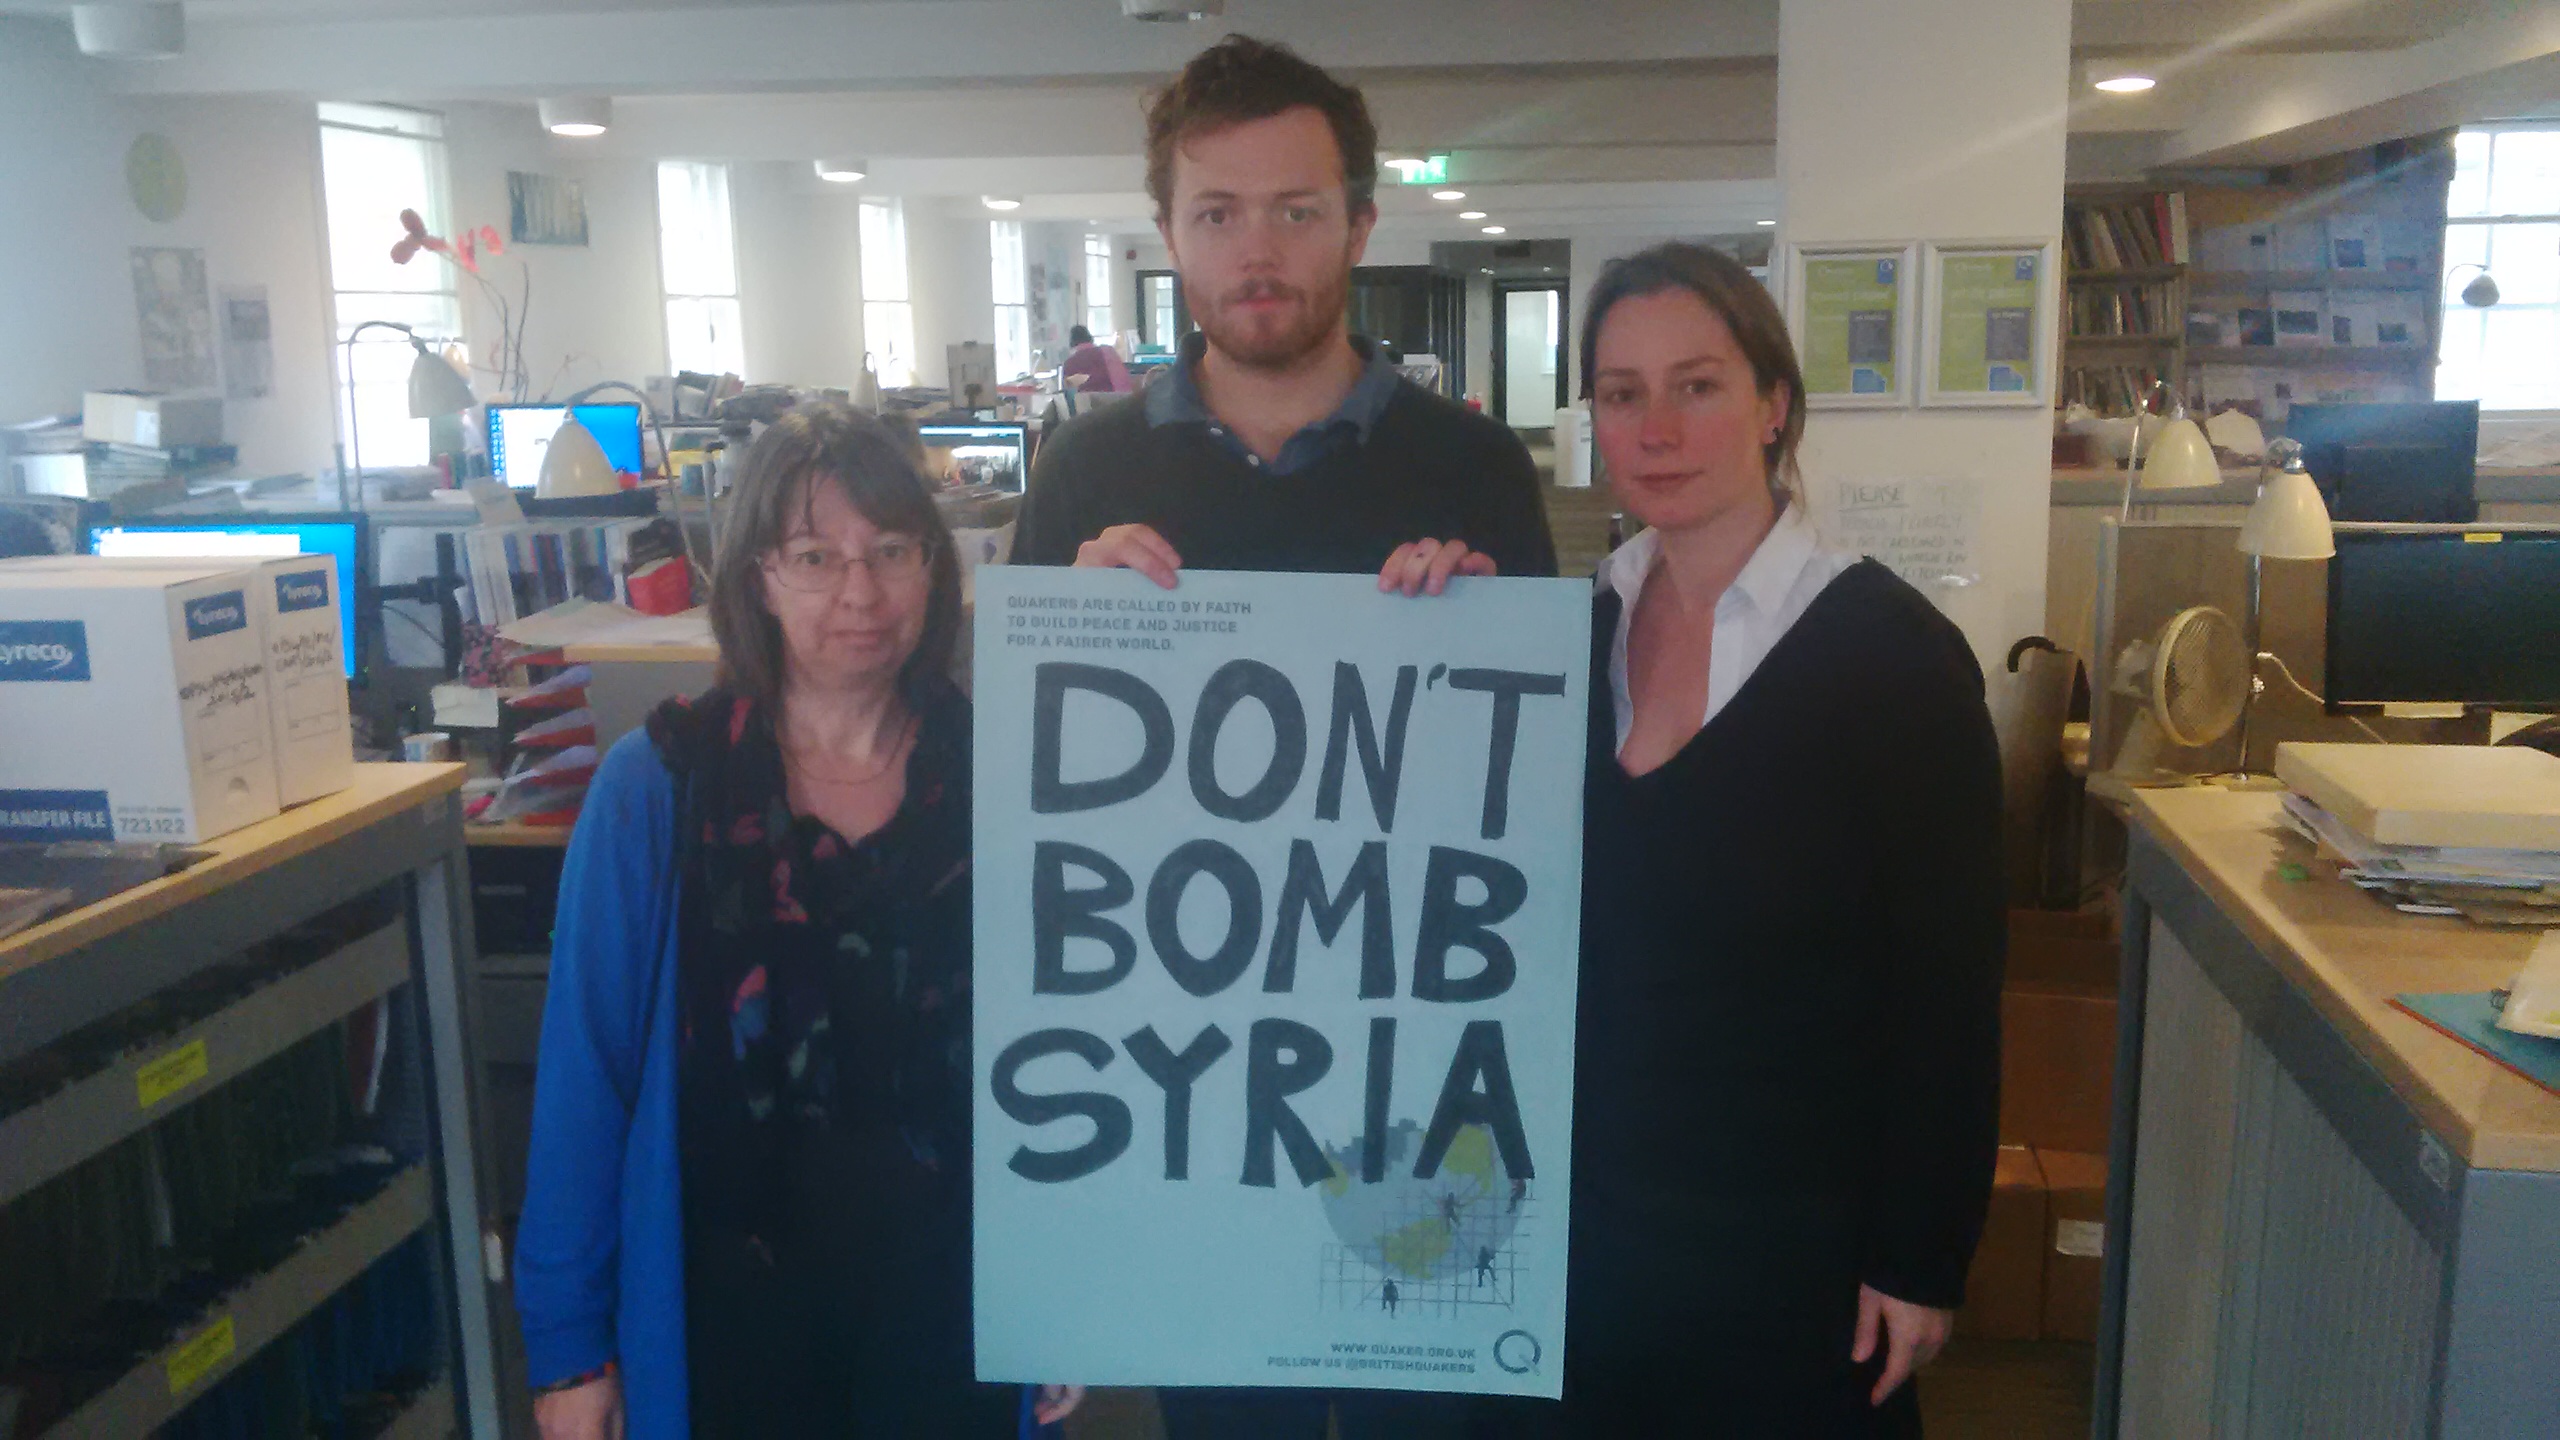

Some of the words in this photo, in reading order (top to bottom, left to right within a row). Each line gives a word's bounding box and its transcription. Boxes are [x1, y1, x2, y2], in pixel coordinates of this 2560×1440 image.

[1838, 482, 1901, 505] PLEASE
[1007, 595, 1078, 611] QUAKERS
[1082, 597, 1113, 611] ARE
[1117, 599, 1176, 613] CALLED
[1181, 600, 1201, 613] BY
[1206, 601, 1252, 615] FAITH
[1007, 615, 1026, 627] TO
[1031, 616, 1078, 629] BUILD
[1082, 617, 1132, 631] PEACE
[1136, 619, 1167, 631] AND
[1172, 620, 1238, 633] JUSTICE
[1007, 634, 1036, 647] FOR
[1040, 635, 1051, 647] A
[1056, 635, 1112, 649] FAIRER
[1116, 637, 1176, 651] WORLD.
[1031, 659, 1567, 840] DON'T
[73, 810, 107, 828] FILE
[1032, 838, 1528, 1003] BOMB
[991, 1017, 1536, 1188] SYRIA
[1267, 1356, 1320, 1368] FOLLOW
[1324, 1357, 1342, 1368] US
[1345, 1358, 1476, 1374] @BRITISHQUAKERS
